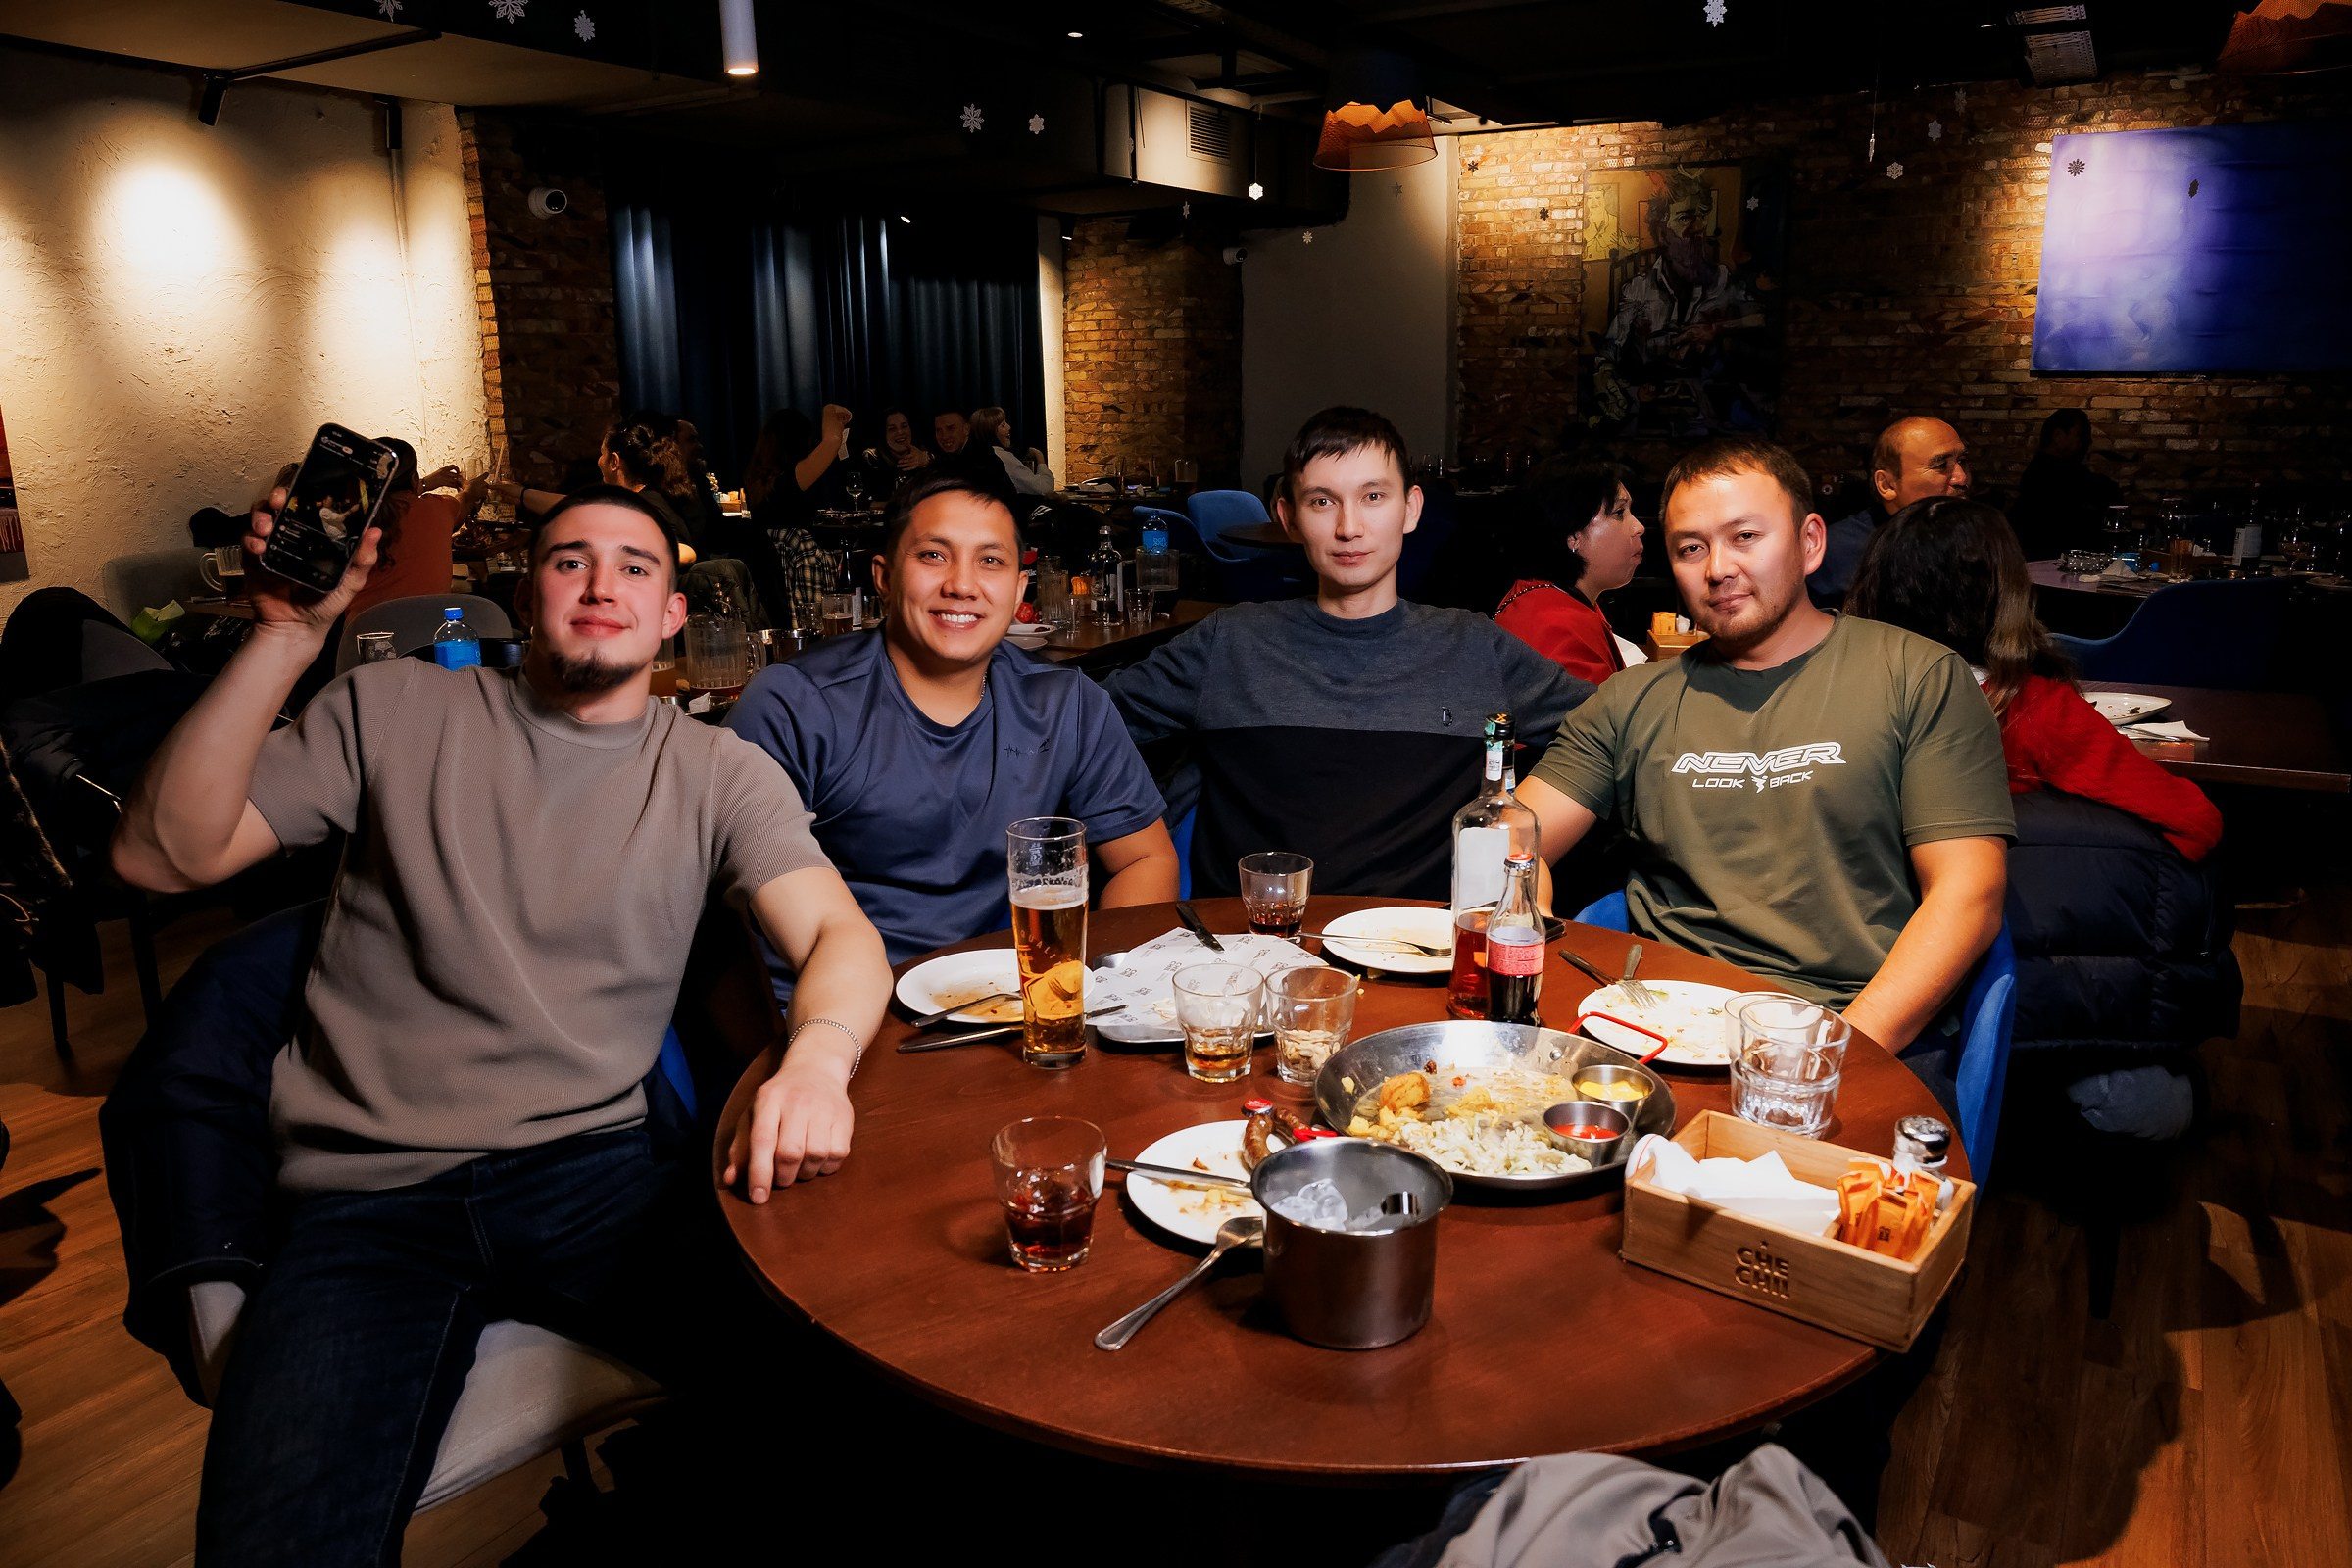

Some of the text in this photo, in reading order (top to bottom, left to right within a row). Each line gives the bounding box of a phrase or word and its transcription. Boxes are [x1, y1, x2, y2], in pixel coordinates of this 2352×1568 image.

[1671, 741, 1847, 776] NEVER
[1691, 770, 1814, 789] LOOK BACK
[1736, 1247, 1789, 1280] CHE
